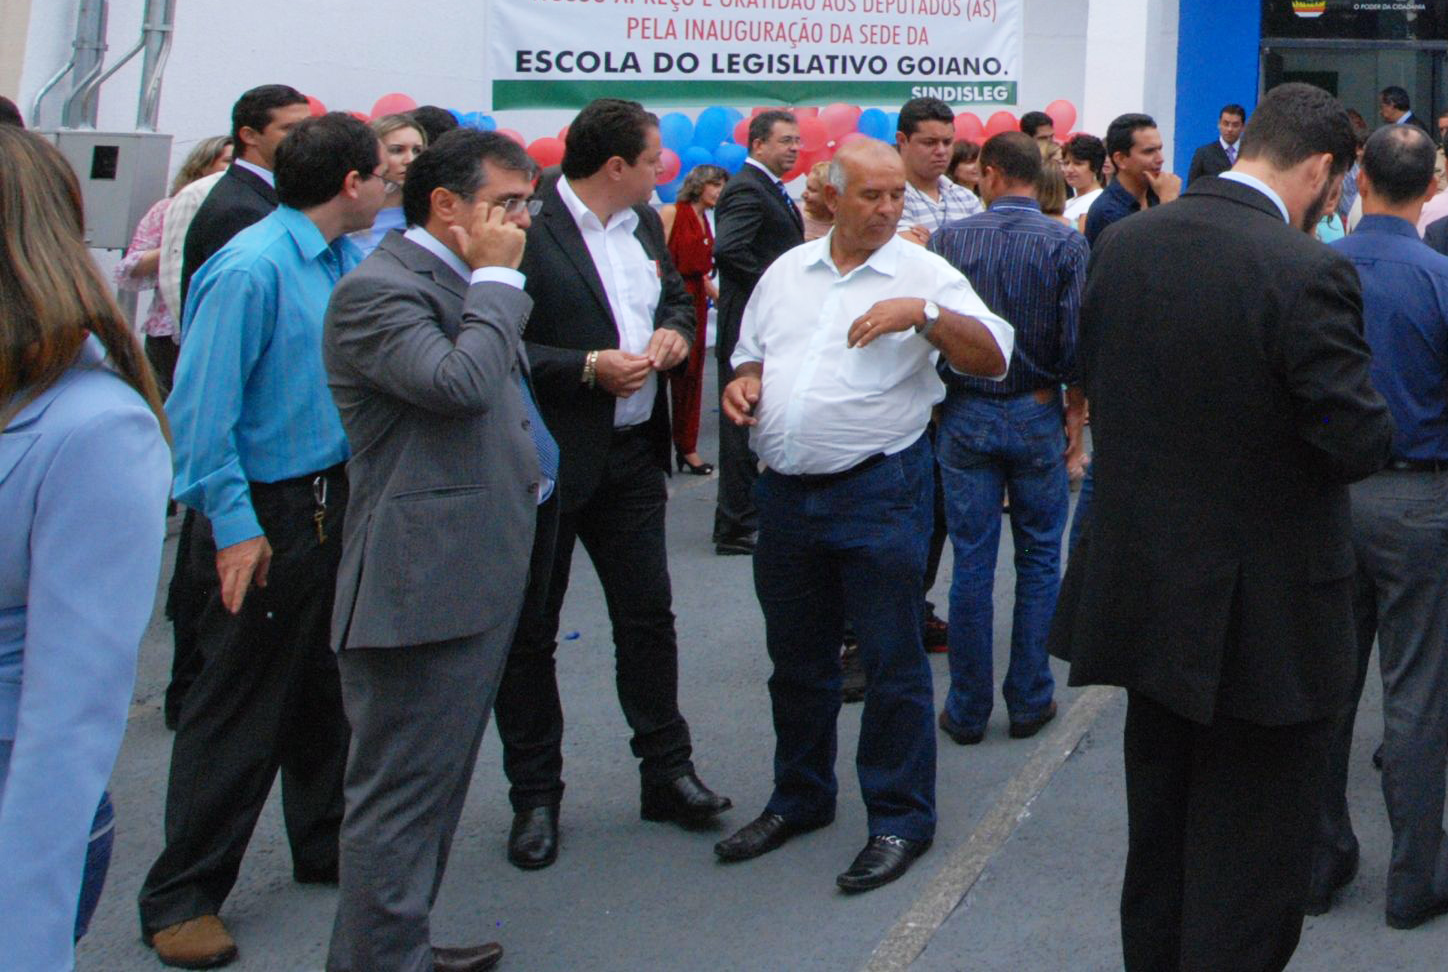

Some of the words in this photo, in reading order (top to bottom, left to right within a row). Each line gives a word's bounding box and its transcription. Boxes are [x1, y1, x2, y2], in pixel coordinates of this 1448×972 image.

[626, 17, 679, 41] PELA
[685, 16, 824, 49] INAUGURAÇÃO
[829, 23, 854, 45] DA
[859, 24, 901, 46] SEDE
[906, 26, 930, 46] DA
[515, 49, 643, 74] ESCOLA
[653, 51, 700, 75] DO
[711, 52, 889, 76] LEGISLATIVO
[896, 56, 1009, 76] GOIANO.
[911, 85, 1009, 102] SINDISLEG
